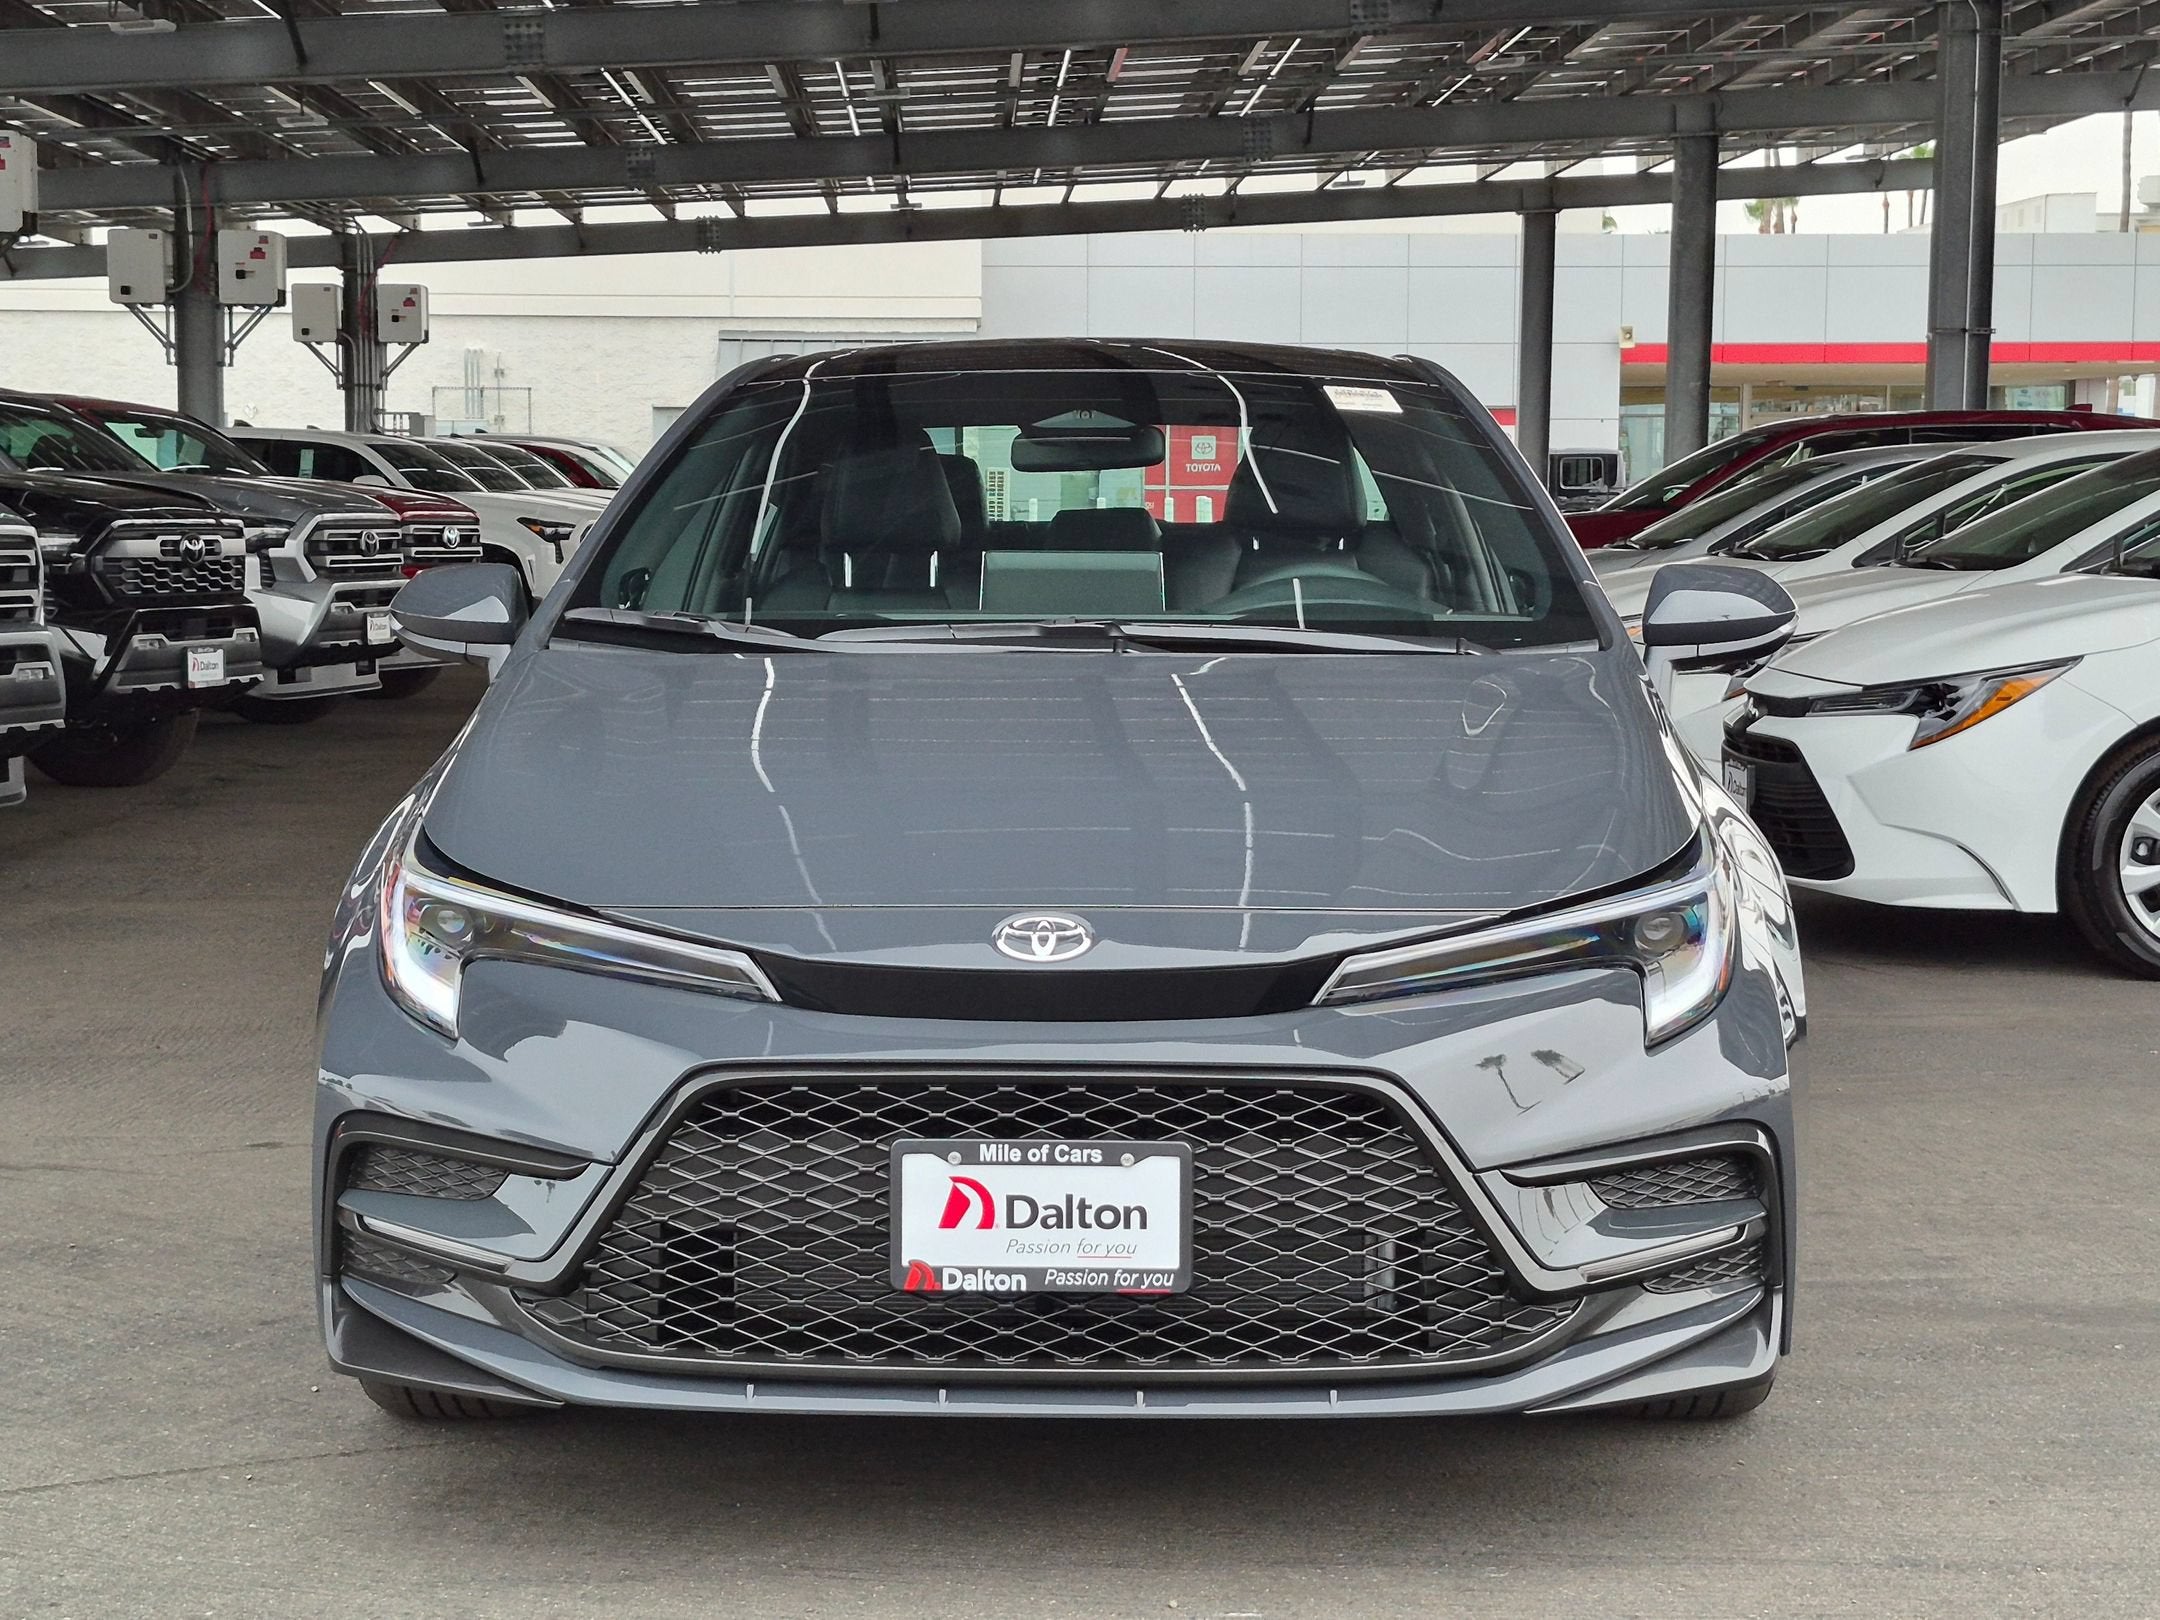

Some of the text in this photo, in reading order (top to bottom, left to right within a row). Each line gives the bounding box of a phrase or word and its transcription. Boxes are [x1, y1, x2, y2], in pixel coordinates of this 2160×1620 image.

[1186, 463, 1221, 472] TOYOTA
[200, 660, 219, 671] Don
[979, 1144, 1103, 1163] Mile of Cars
[1005, 1193, 1148, 1230] Dalton
[1005, 1238, 1138, 1257] Passion for you
[942, 1267, 1174, 1291] Dalton Passion for you
